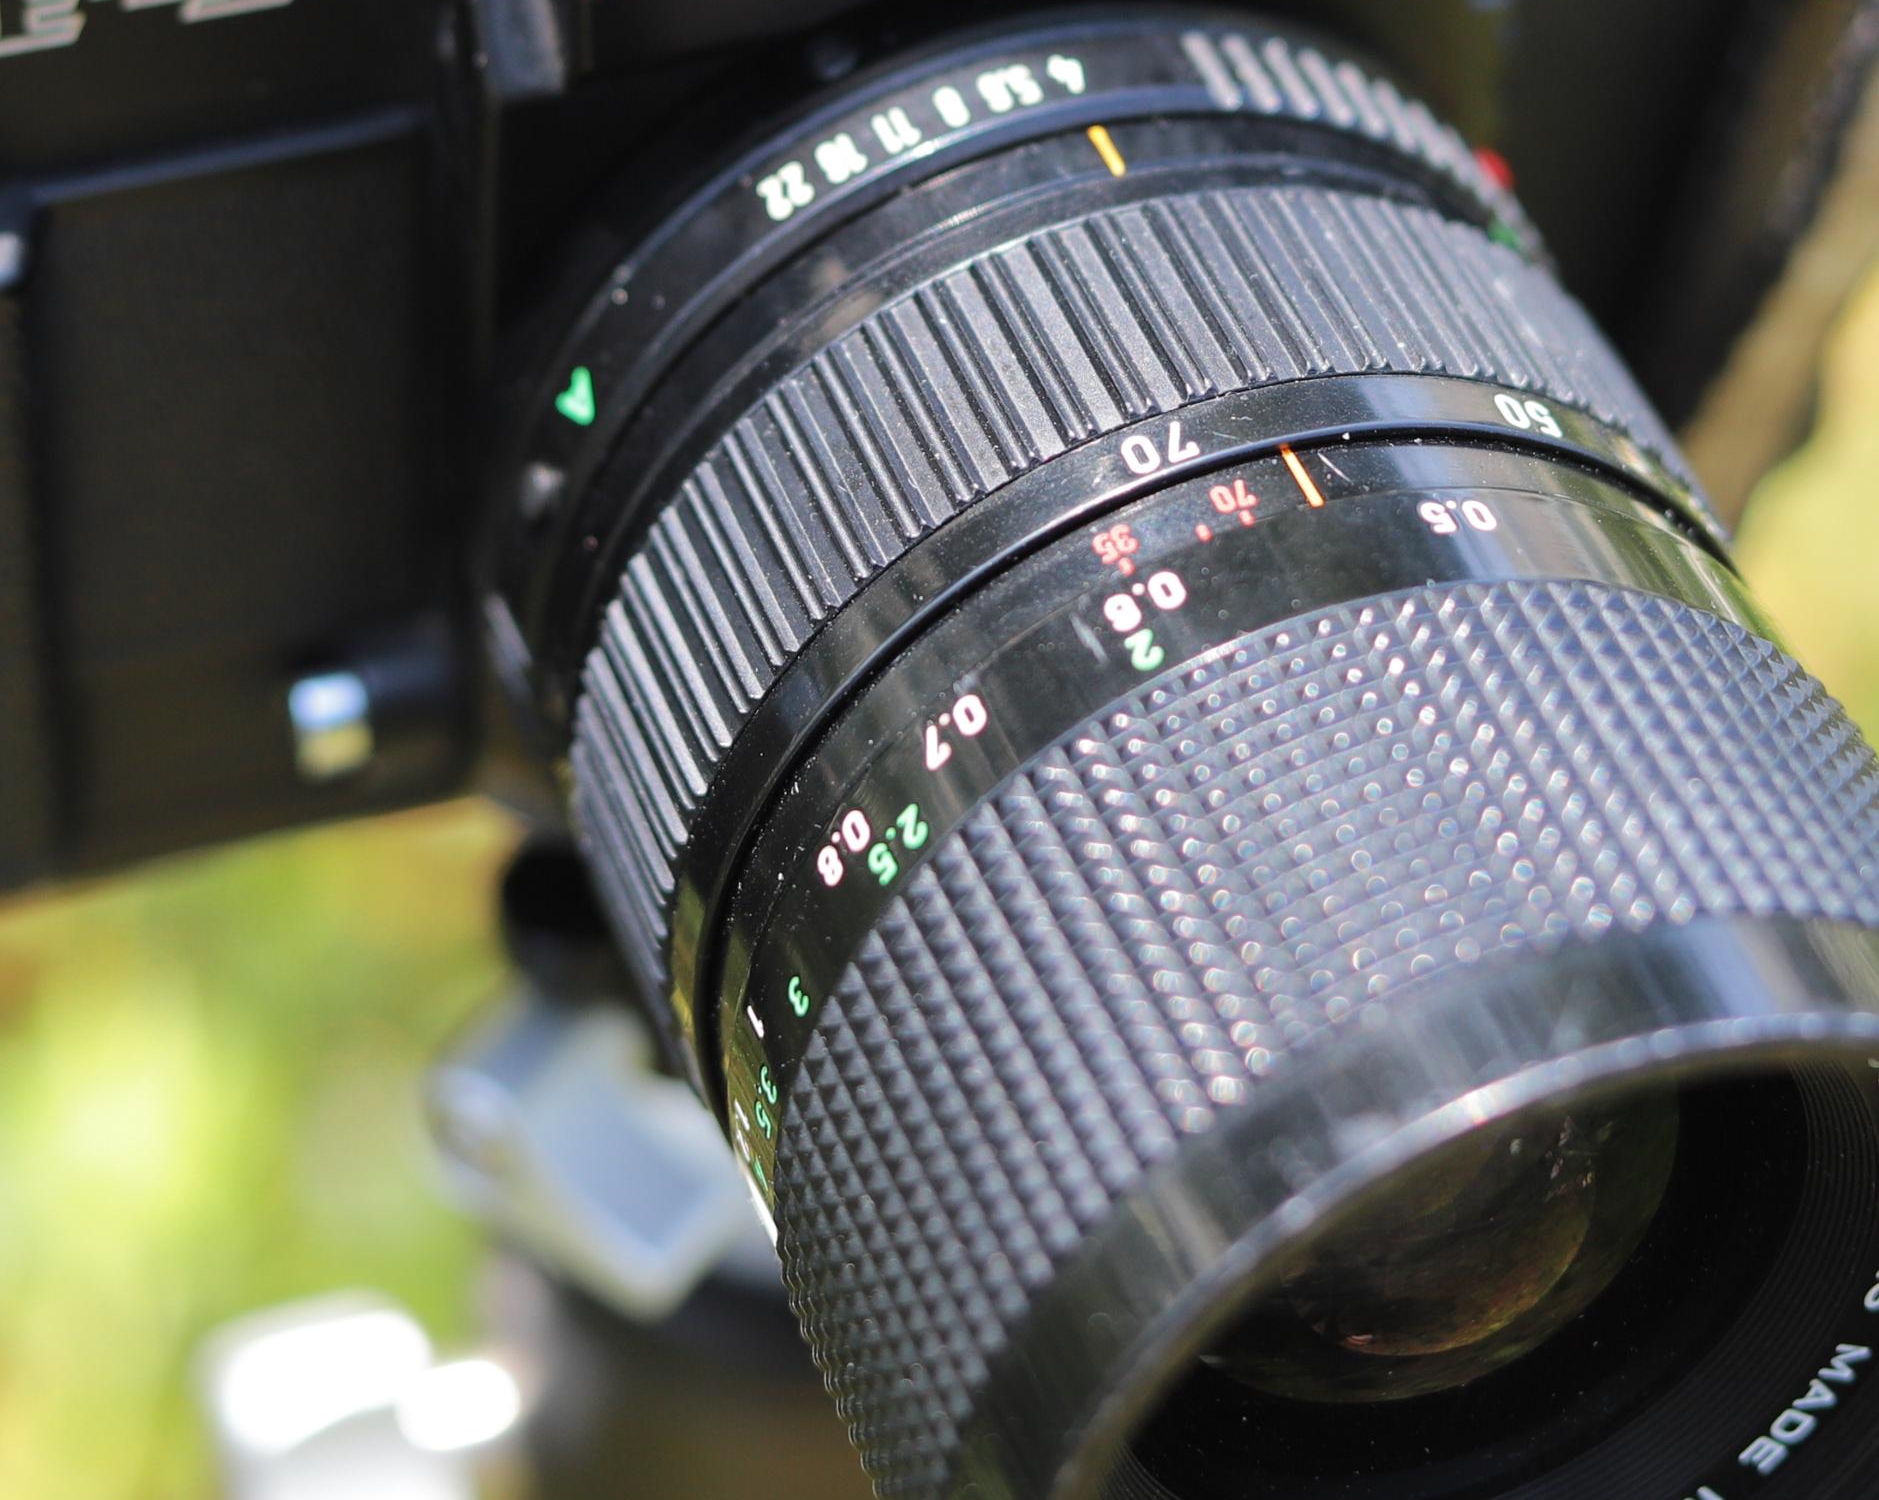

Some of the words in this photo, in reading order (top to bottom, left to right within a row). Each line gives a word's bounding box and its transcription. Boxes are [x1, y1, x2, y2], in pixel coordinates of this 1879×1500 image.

[1046, 54, 1085, 94] 4
[871, 107, 922, 154] 11
[756, 161, 815, 221] 22
[1120, 421, 1201, 475] 70
[1494, 393, 1563, 439] 50
[1209, 479, 1259, 516] 70
[1419, 499, 1498, 535] 0.5
[1091, 523, 1140, 565] 35
[1103, 570, 1188, 634] 0.6
[1124, 628, 1165, 672] 2
[926, 694, 987, 771] 0.7
[817, 809, 871, 887] 0.8
[868, 803, 928, 886] 2.5
[788, 976, 810, 1017] 3
[757, 1065, 777, 1139] 3.5
[1740, 1344, 1871, 1473] MADE
